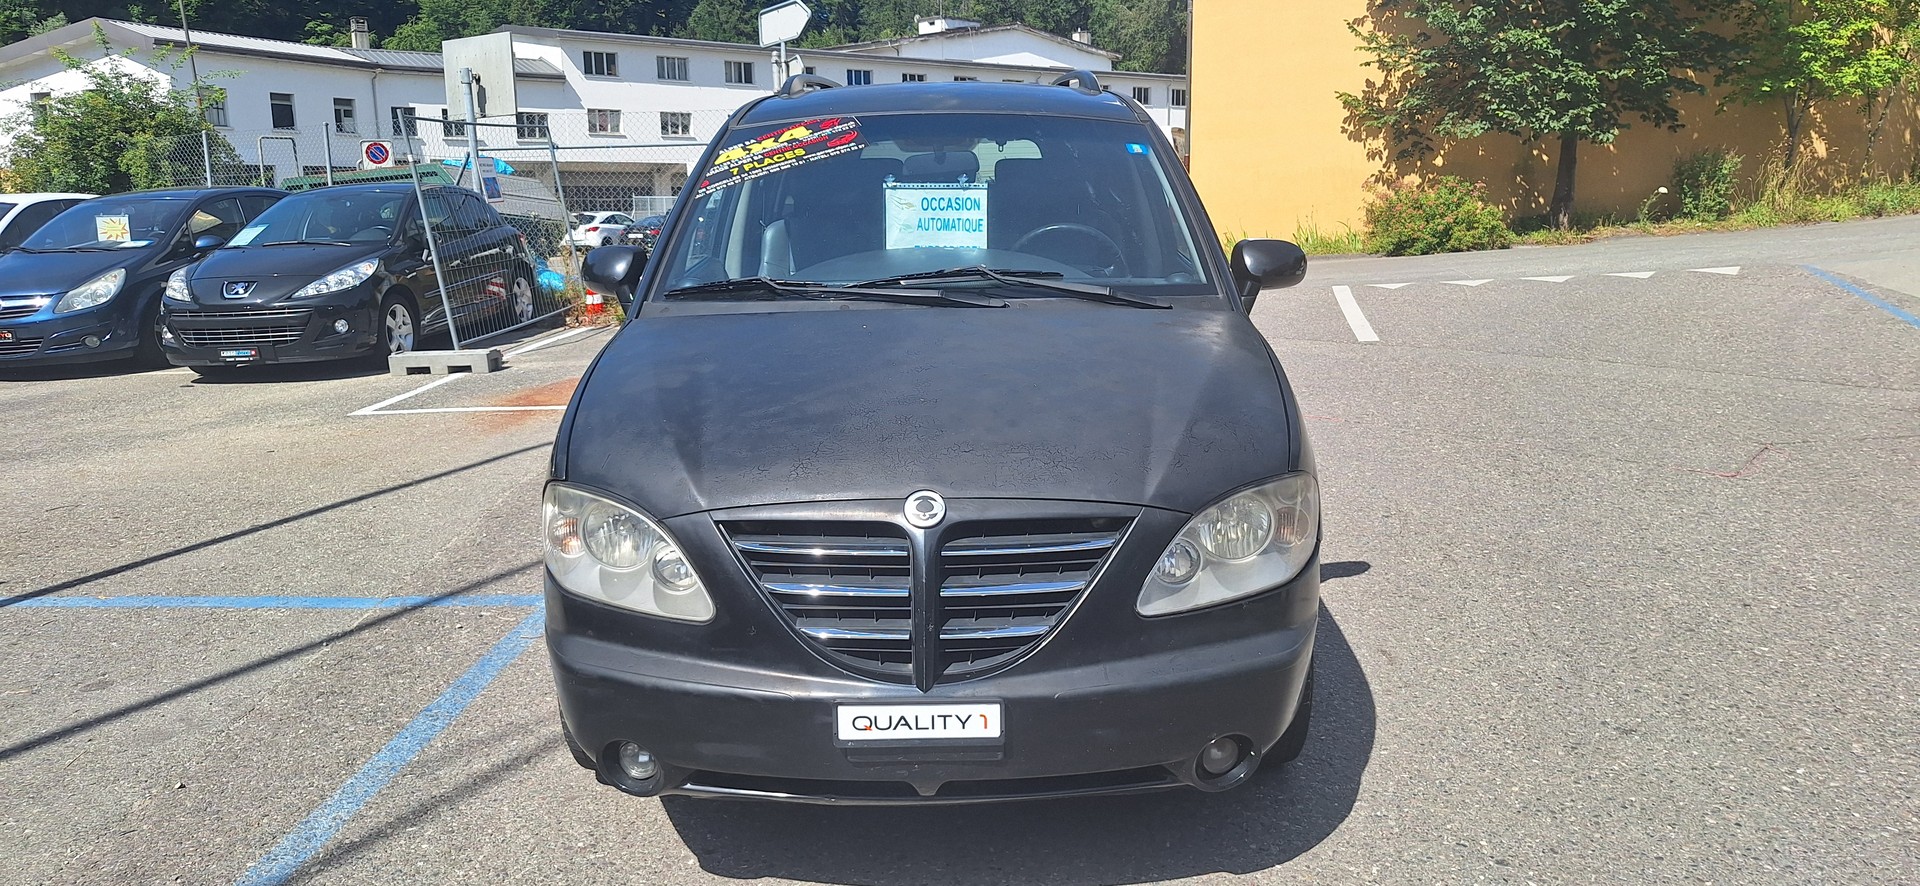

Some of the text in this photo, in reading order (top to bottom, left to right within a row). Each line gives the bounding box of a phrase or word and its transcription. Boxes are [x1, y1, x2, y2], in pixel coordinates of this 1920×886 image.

[763, 145, 791, 157] CENTRE
[792, 135, 829, 149] OCCASION
[730, 167, 739, 176] 7
[743, 148, 806, 172] PLACES
[921, 197, 981, 212] OCCASION
[916, 217, 984, 233] AUTOMATIQUE
[852, 714, 988, 731] QUALITY 1
